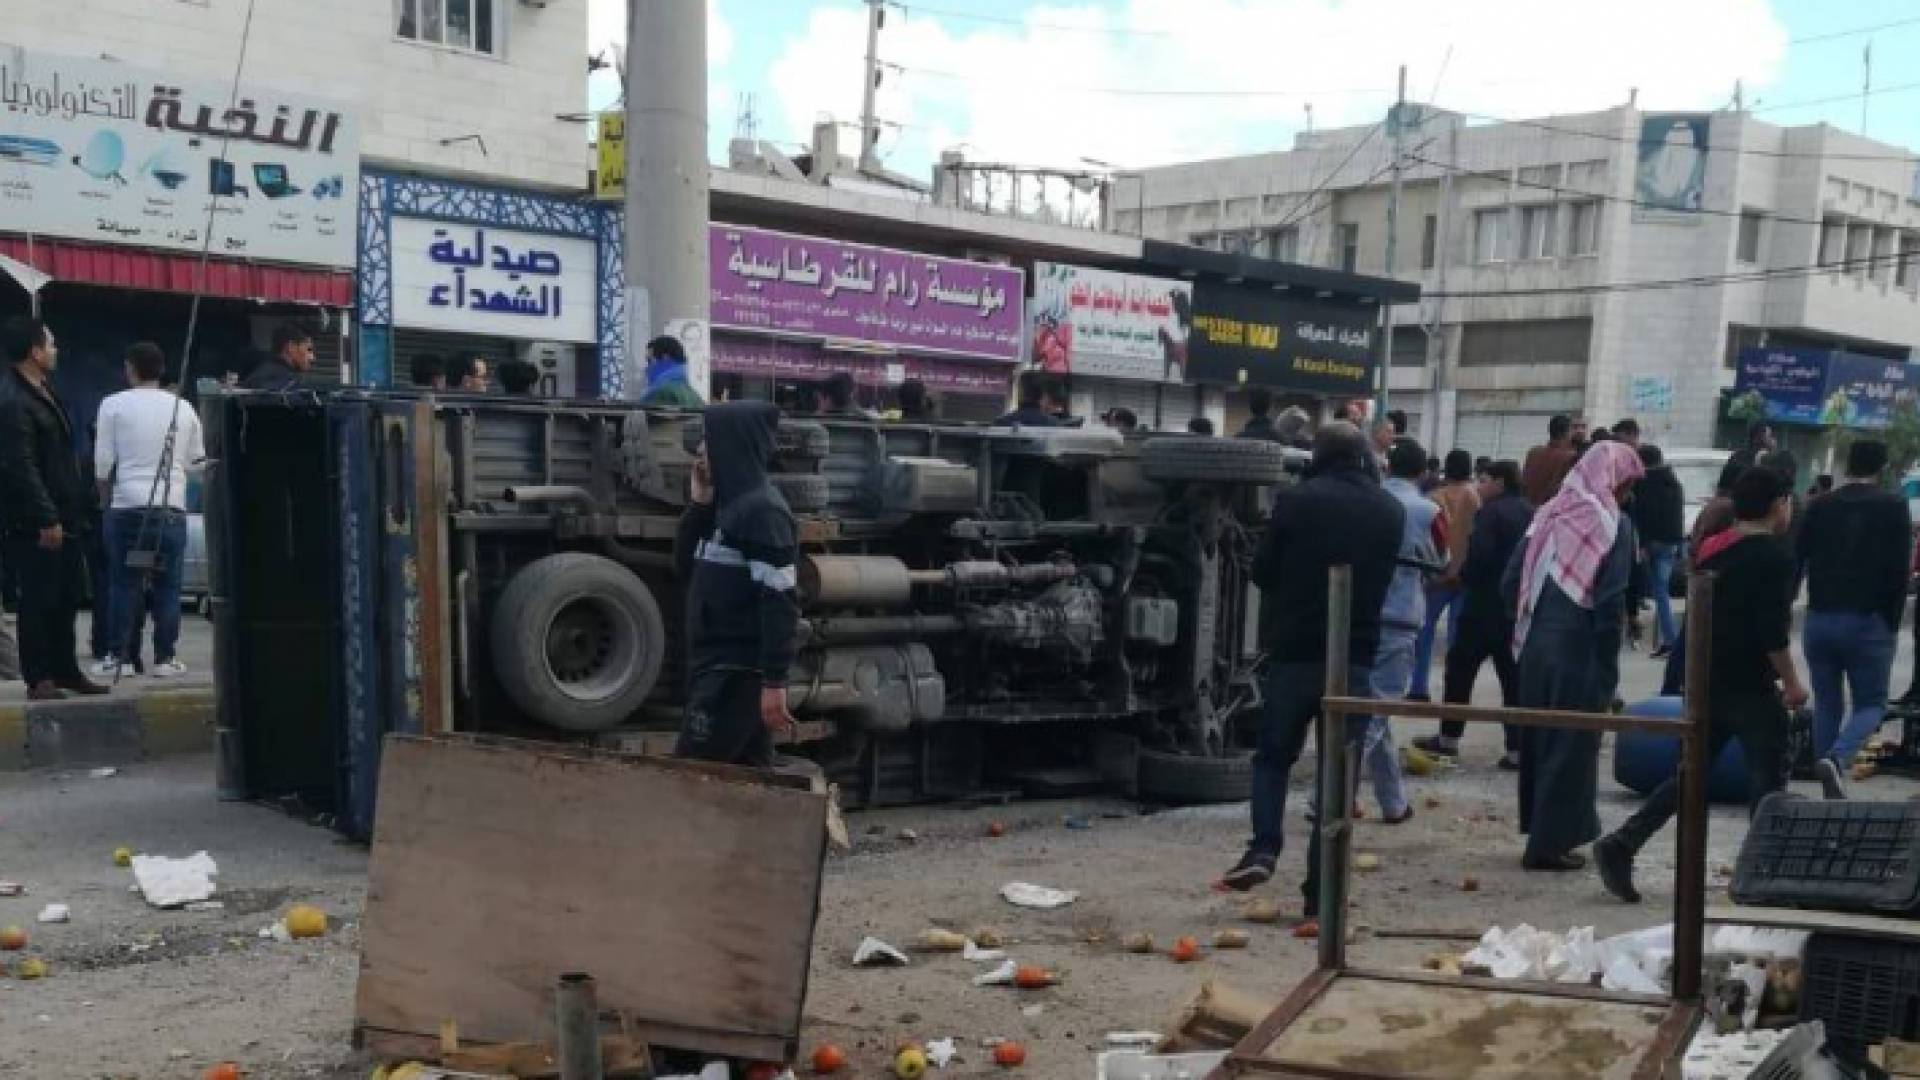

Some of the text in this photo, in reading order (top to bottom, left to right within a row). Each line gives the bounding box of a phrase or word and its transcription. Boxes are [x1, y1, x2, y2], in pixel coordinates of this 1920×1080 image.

[146, 85, 342, 153] النخبة
[428, 228, 562, 281] صيدلية
[726, 231, 879, 299] للقرطاسية
[427, 272, 564, 318] الشهداء
[882, 258, 920, 307] رام
[926, 260, 1006, 317] مؤسسة
